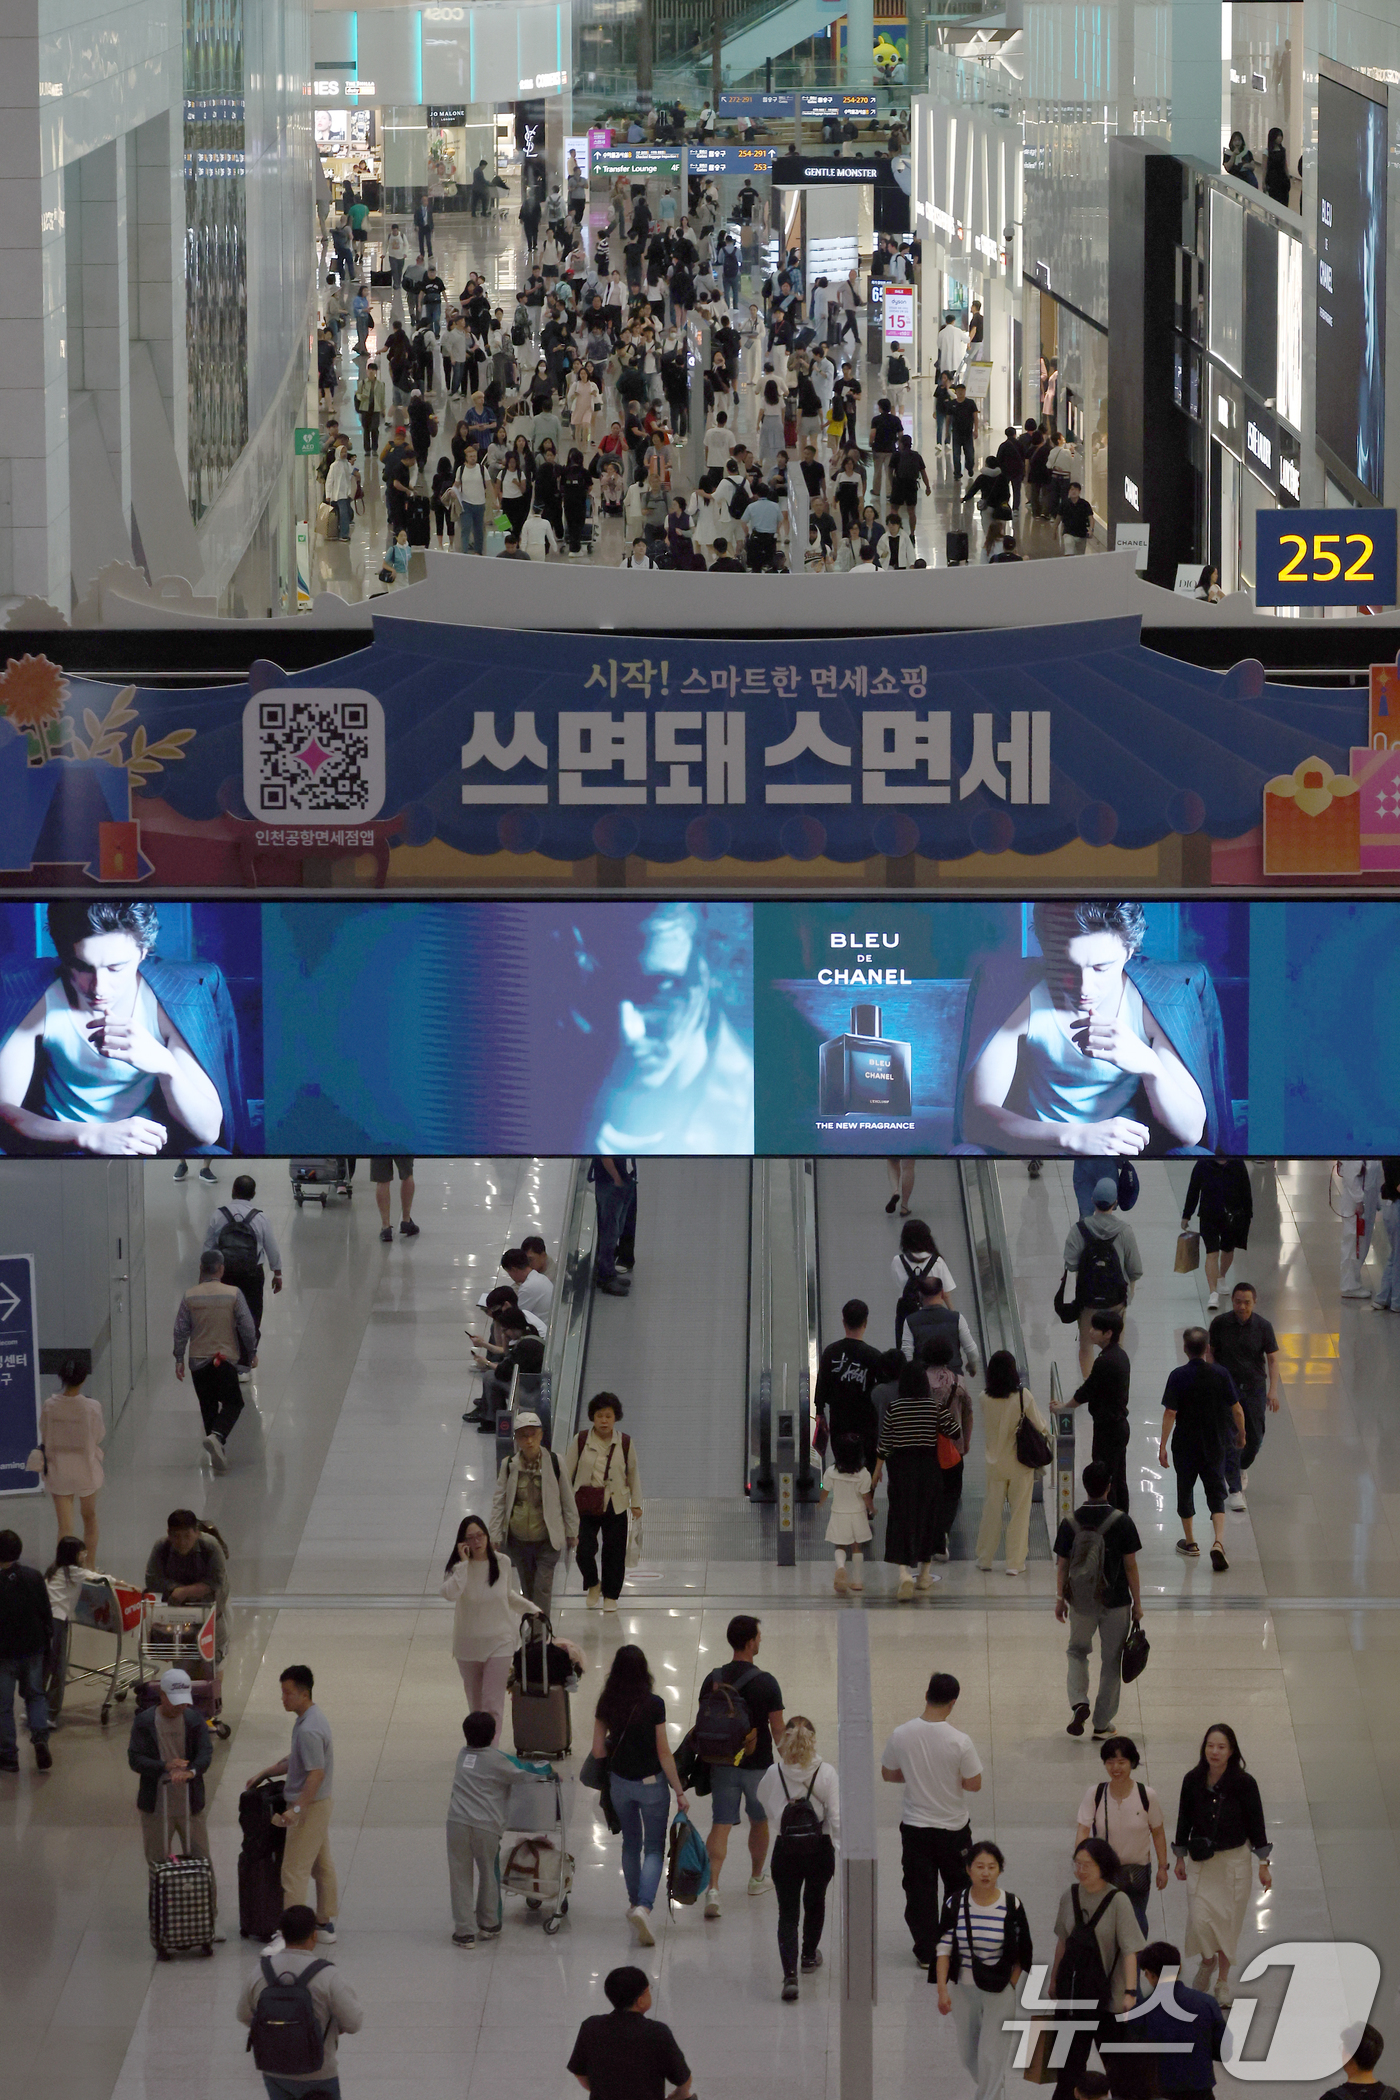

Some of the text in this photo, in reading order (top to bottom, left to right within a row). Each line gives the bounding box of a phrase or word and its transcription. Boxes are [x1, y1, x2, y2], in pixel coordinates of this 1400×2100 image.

[842, 96, 869, 104] 254-270
[738, 149, 767, 158] 254-291
[602, 165, 630, 173] Transfer
[631, 165, 658, 173] Lounge
[670, 163, 680, 171] 4F
[753, 163, 767, 171] 253
[804, 167, 877, 178] GENTLE MONSTER
[888, 314, 906, 329] 15
[1278, 534, 1375, 582] 252
[584, 658, 928, 699] 시작! 스마트한 면세쇼핑
[255, 829, 375, 847] 인천공항면세점앱
[830, 933, 900, 948] BLEU
[857, 954, 873, 963] DE
[817, 968, 912, 985] CHANEL
[869, 1059, 891, 1067] BLEU
[864, 1071, 895, 1081] CHANEL
[815, 1122, 915, 1130] THE NEW FRAGRANCE
